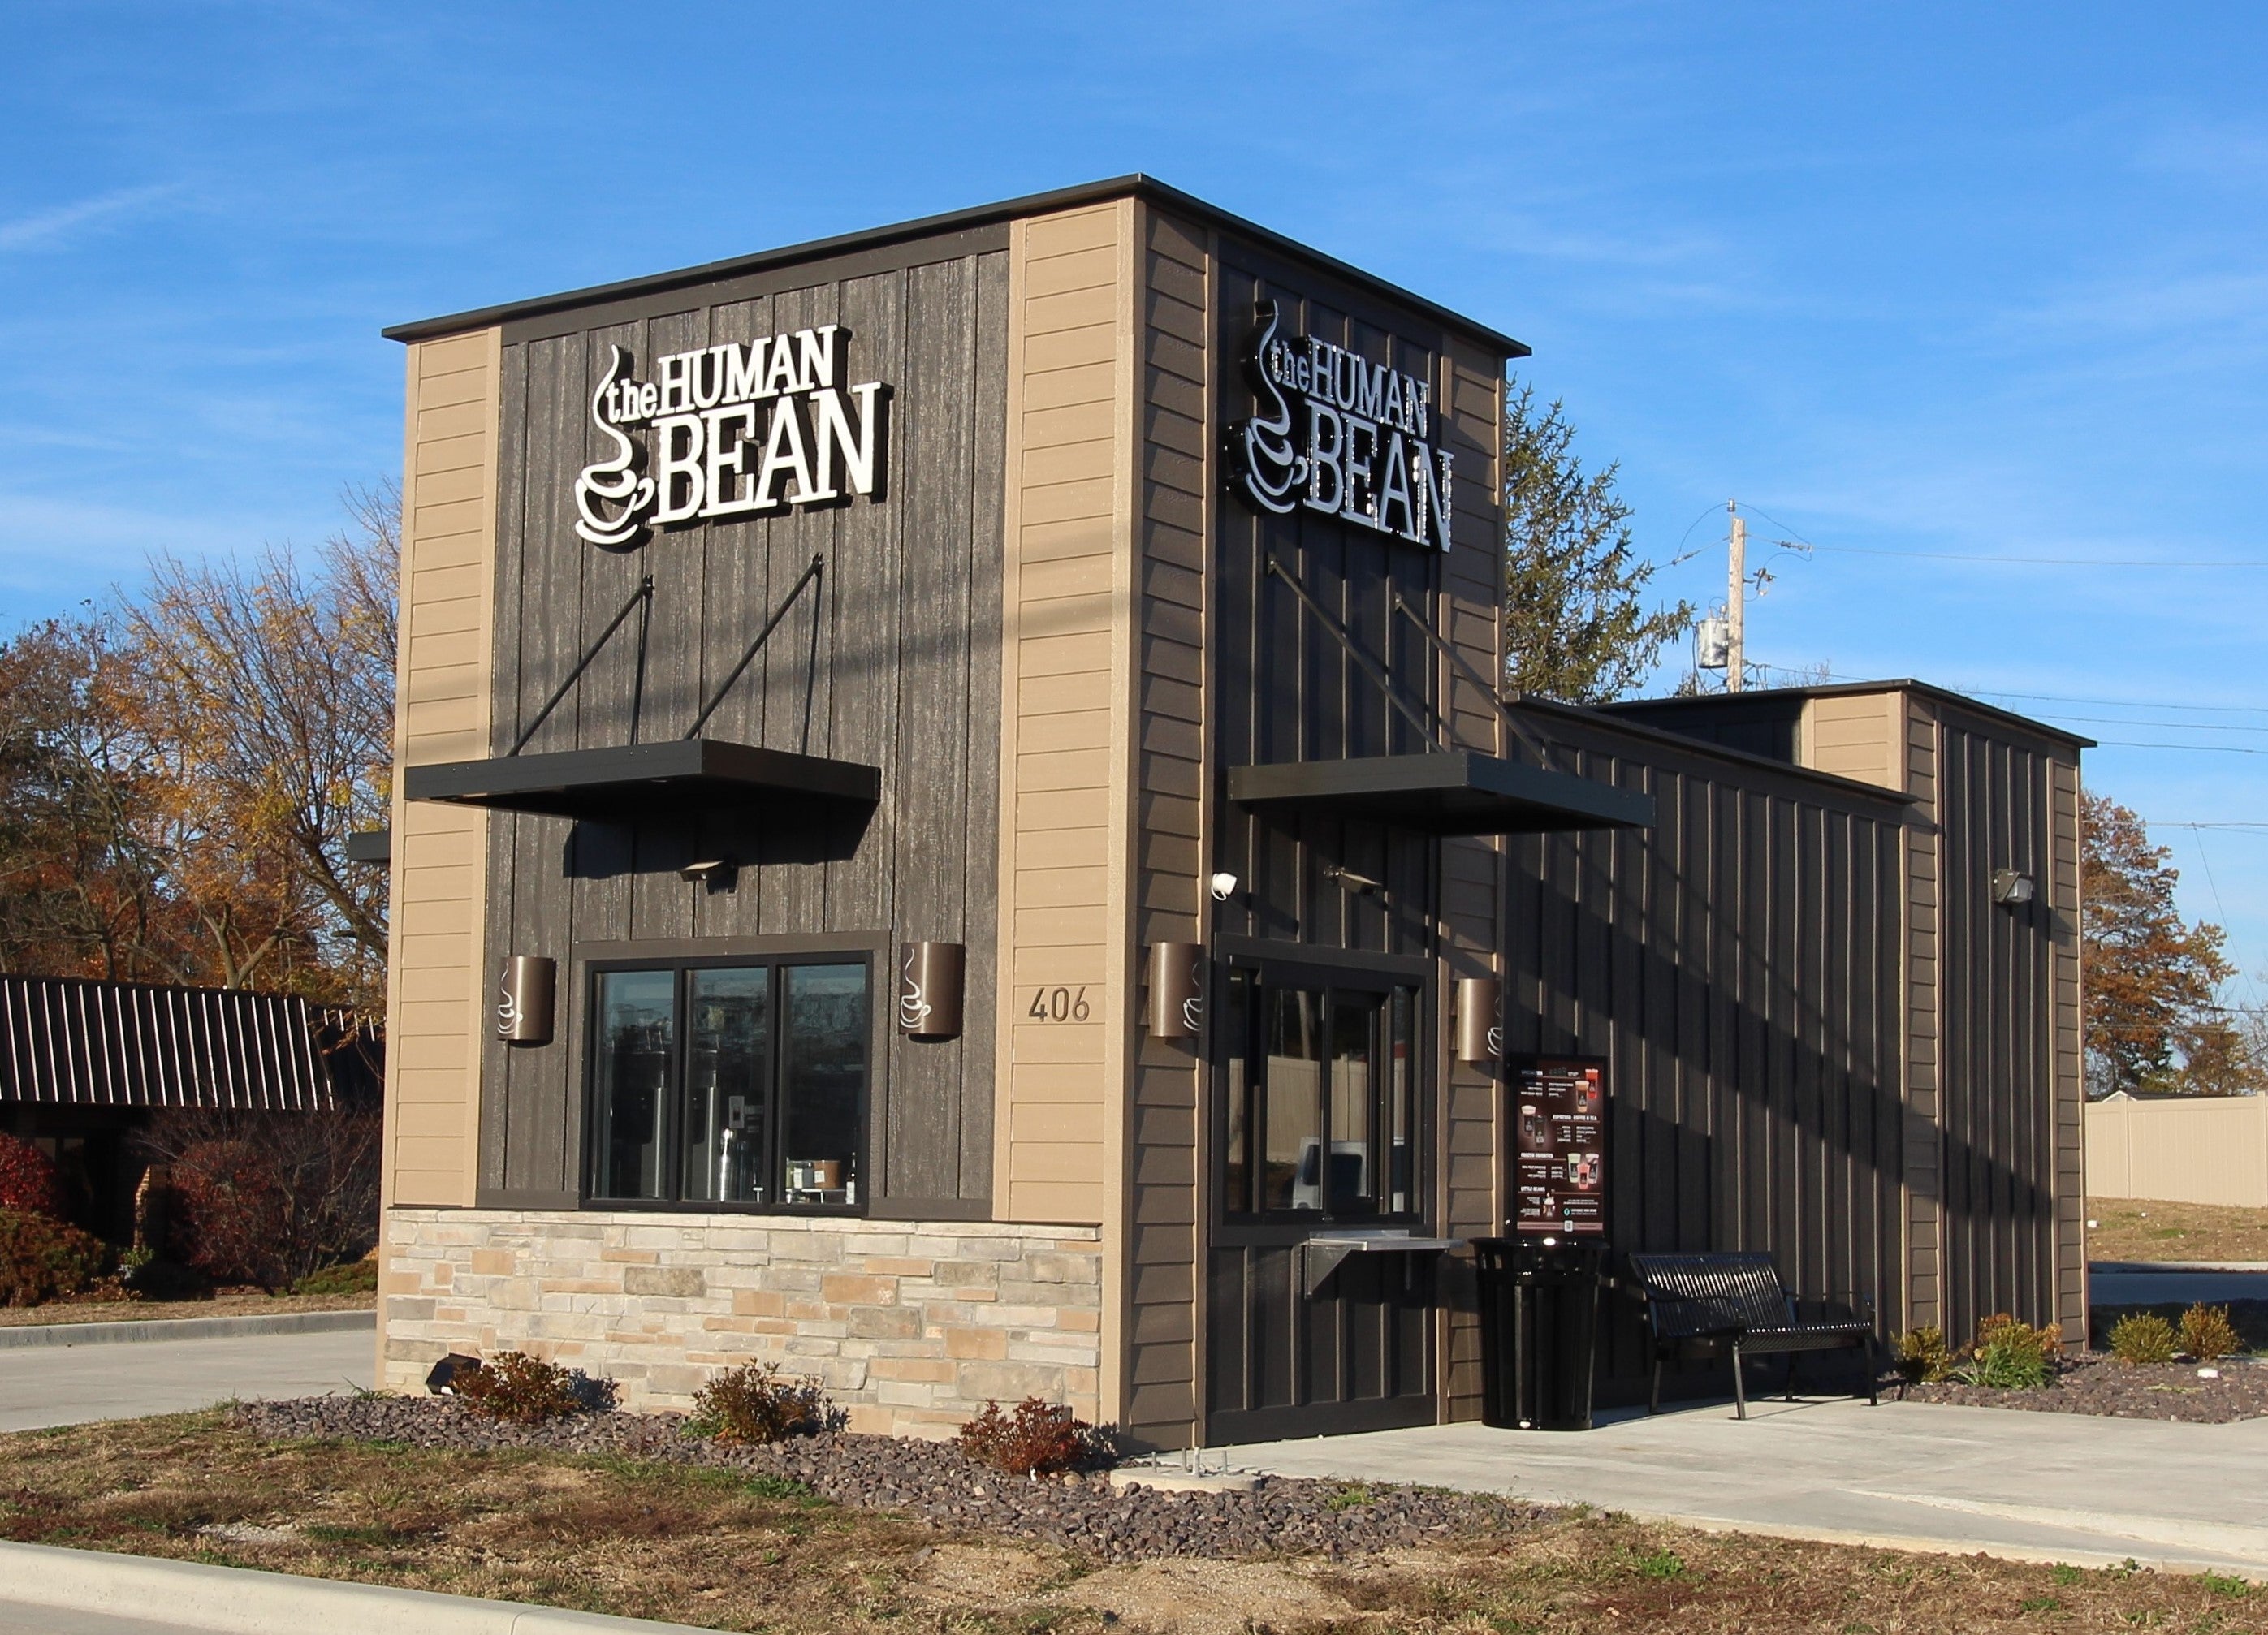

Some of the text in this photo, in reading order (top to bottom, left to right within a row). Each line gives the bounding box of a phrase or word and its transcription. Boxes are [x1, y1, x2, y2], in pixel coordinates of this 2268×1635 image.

[606, 325, 839, 423] the HUMAN
[1270, 334, 1429, 438] the HUMAN
[650, 382, 882, 524] BEAN
[1302, 398, 1454, 554] BEAN
[1028, 986, 1091, 1022] 406
